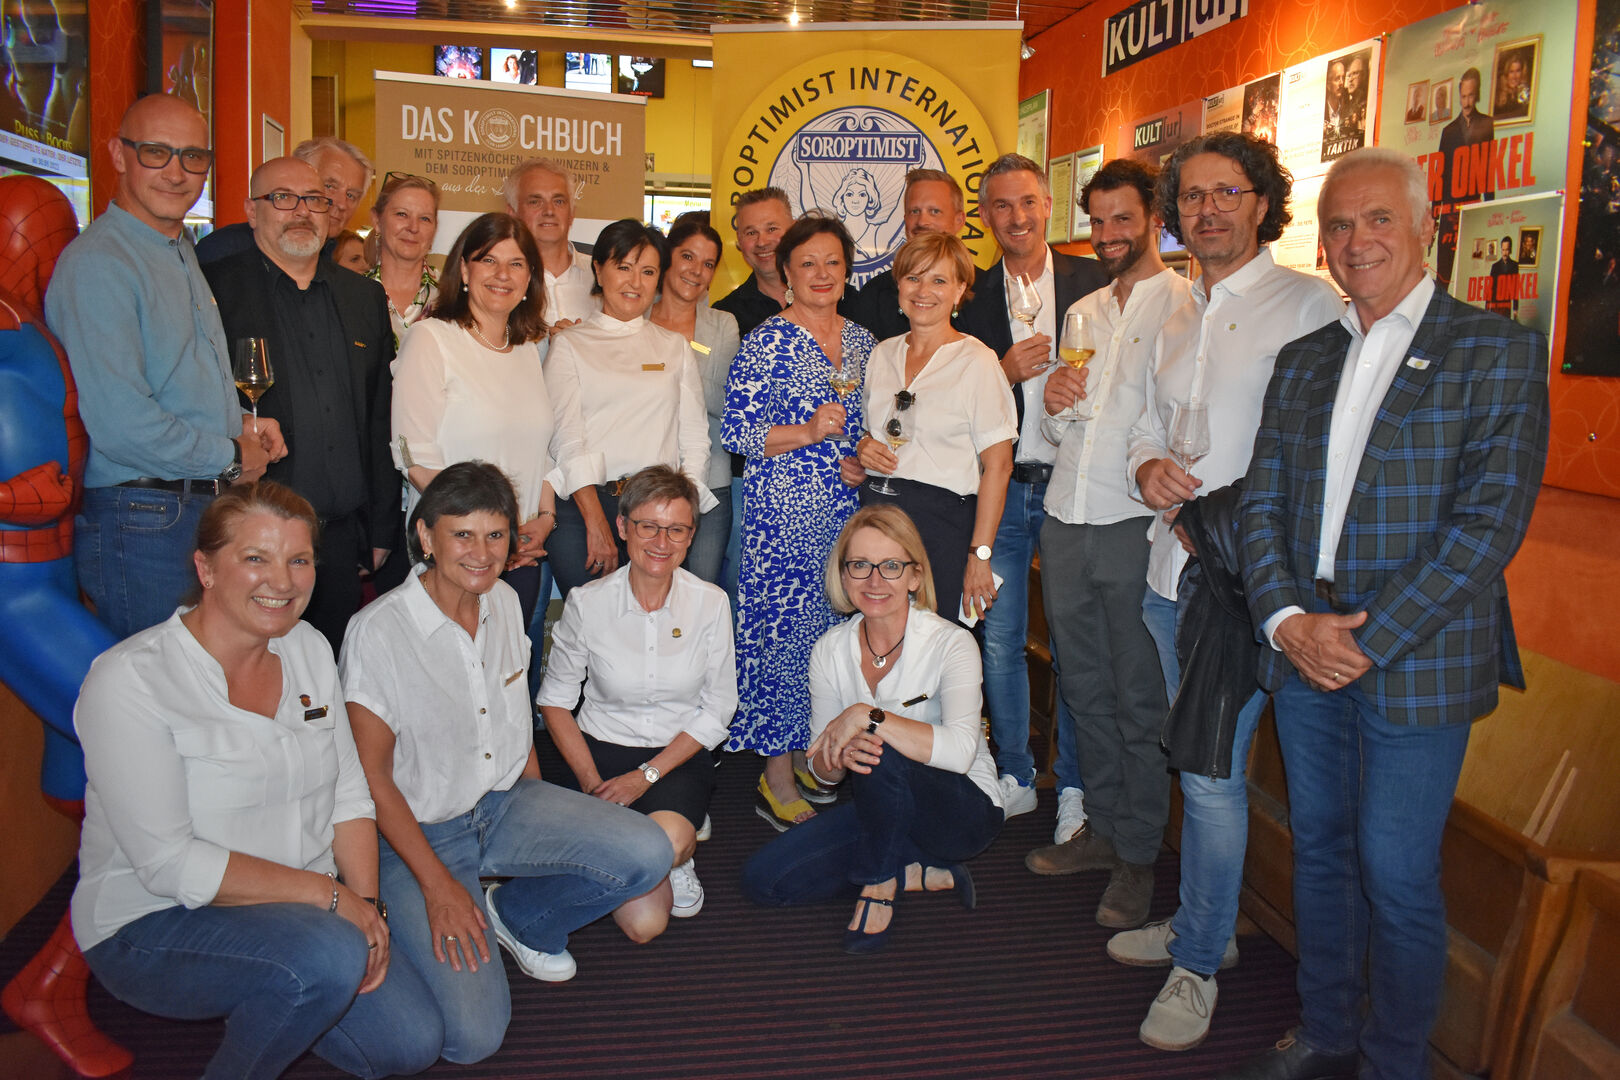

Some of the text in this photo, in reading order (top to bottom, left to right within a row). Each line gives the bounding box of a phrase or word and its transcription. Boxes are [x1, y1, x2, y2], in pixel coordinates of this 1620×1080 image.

[402, 105, 454, 143] DAS
[415, 149, 433, 159] MIT
[602, 162, 610, 172] &
[730, 70, 836, 231] ROPTIMIST
[800, 136, 919, 159] SOROPTIMIST
[426, 163, 448, 174] DEM
[452, 164, 513, 179] SOROPTIMI
[1451, 132, 1536, 198] ONKEL
[1467, 272, 1539, 302] DER ONKEL
